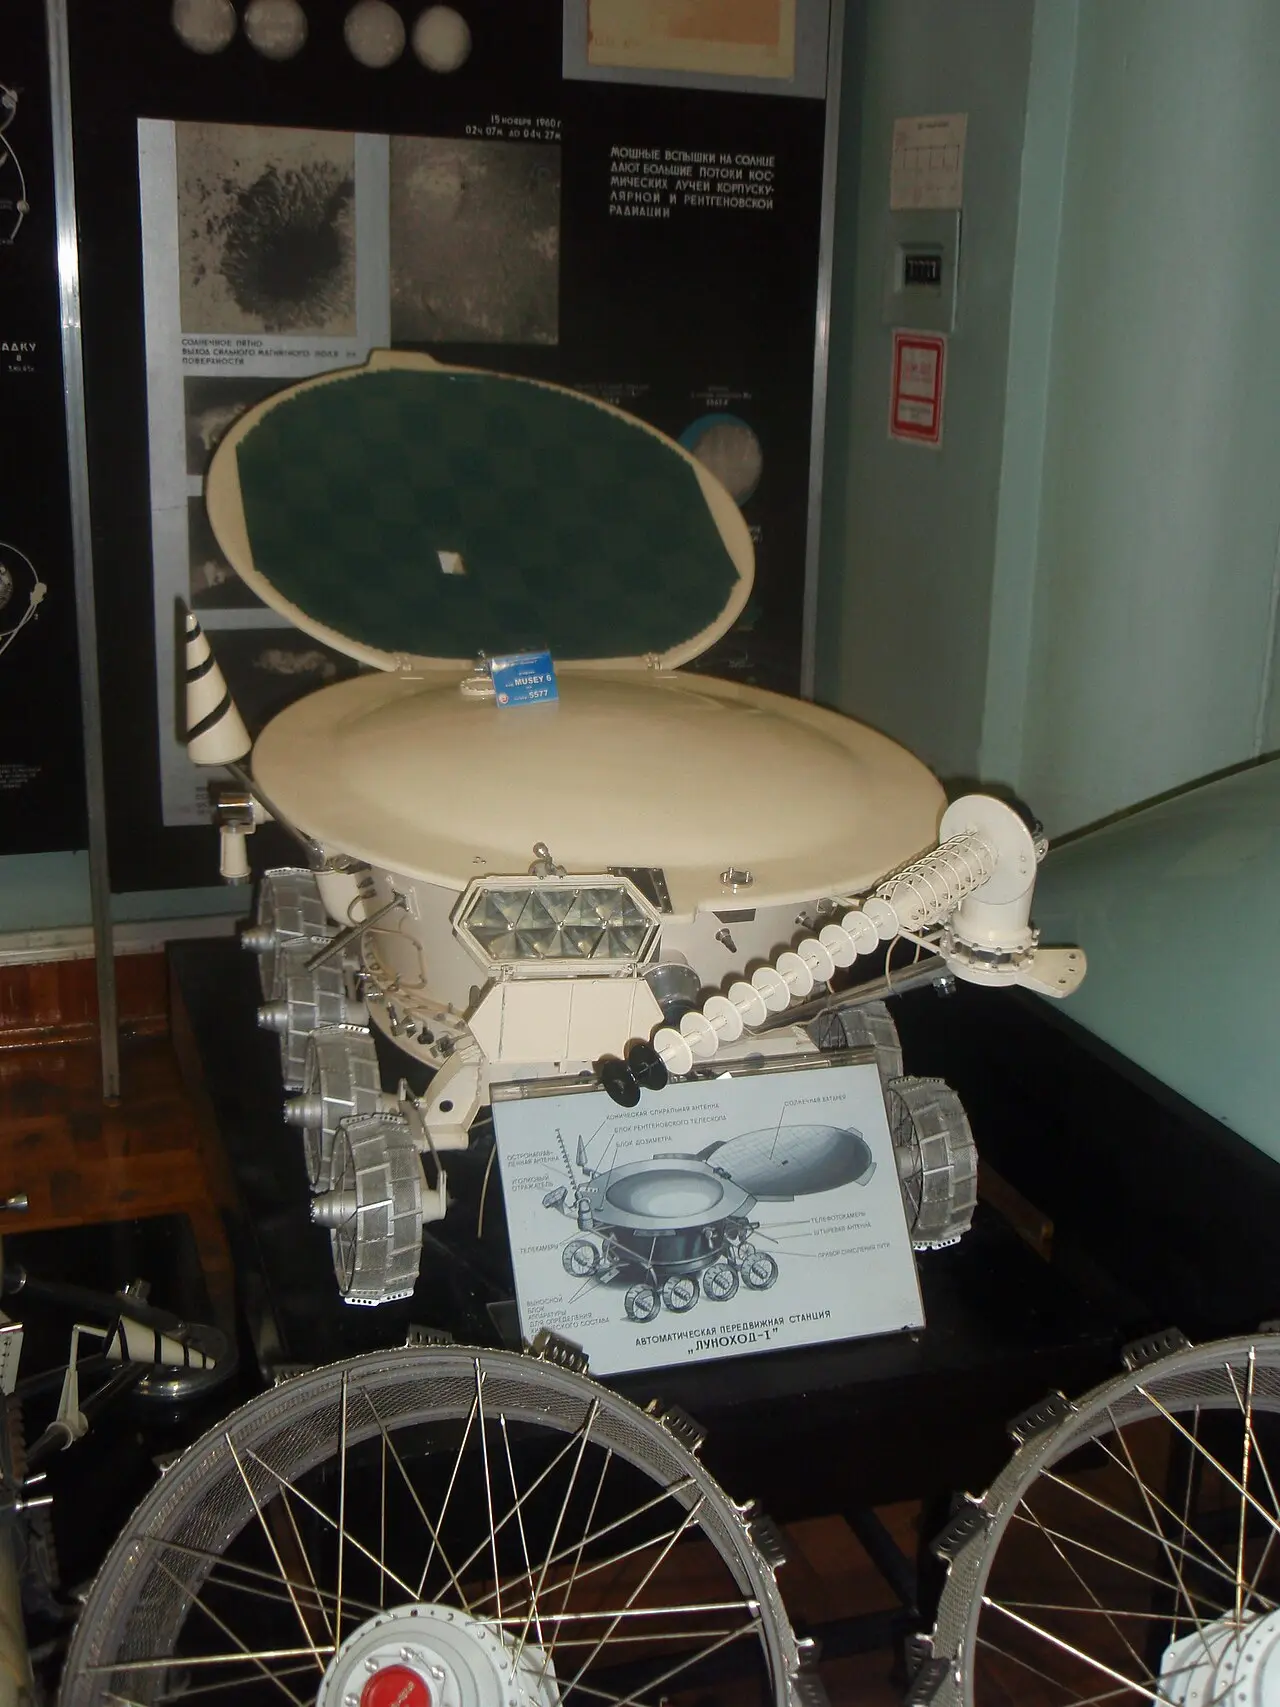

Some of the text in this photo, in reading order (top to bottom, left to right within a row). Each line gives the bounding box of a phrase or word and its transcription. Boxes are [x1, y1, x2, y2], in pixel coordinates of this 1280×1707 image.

[665, 150, 716, 164] ВСПЫШКИ
[719, 153, 732, 166] НА
[735, 154, 775, 168] СОЛНЦЕ
[610, 161, 640, 174] ДАЮТ
[643, 163, 693, 177] БОЛЬШИЕ
[699, 166, 743, 180] ПОТОКИ
[610, 176, 669, 190] МИЧЕСКИХ
[669, 193, 677, 206] И
[609, 204, 671, 219] РАДИАЦИИ
[181, 338, 264, 348] СОЛНЕЧНОЕ ПЯТНО
[182, 348, 210, 356] ВЫХОД
[213, 348, 256, 357] СИЛЬНОГО
[514, 675, 544, 687] MUSEY
[606, 1110, 648, 1121] КОНИЧЕСКАЯ
[649, 1105, 690, 1116] СПИРАЛЬНАЯ
[633, 1119, 689, 1132] РЕНТГЕНОВСКОГО
[635, 1309, 832, 1347] АВТОМАТИЧЕСКАЯ ПЕРЕДВИЖНАЯ СТАНЦИЯ
